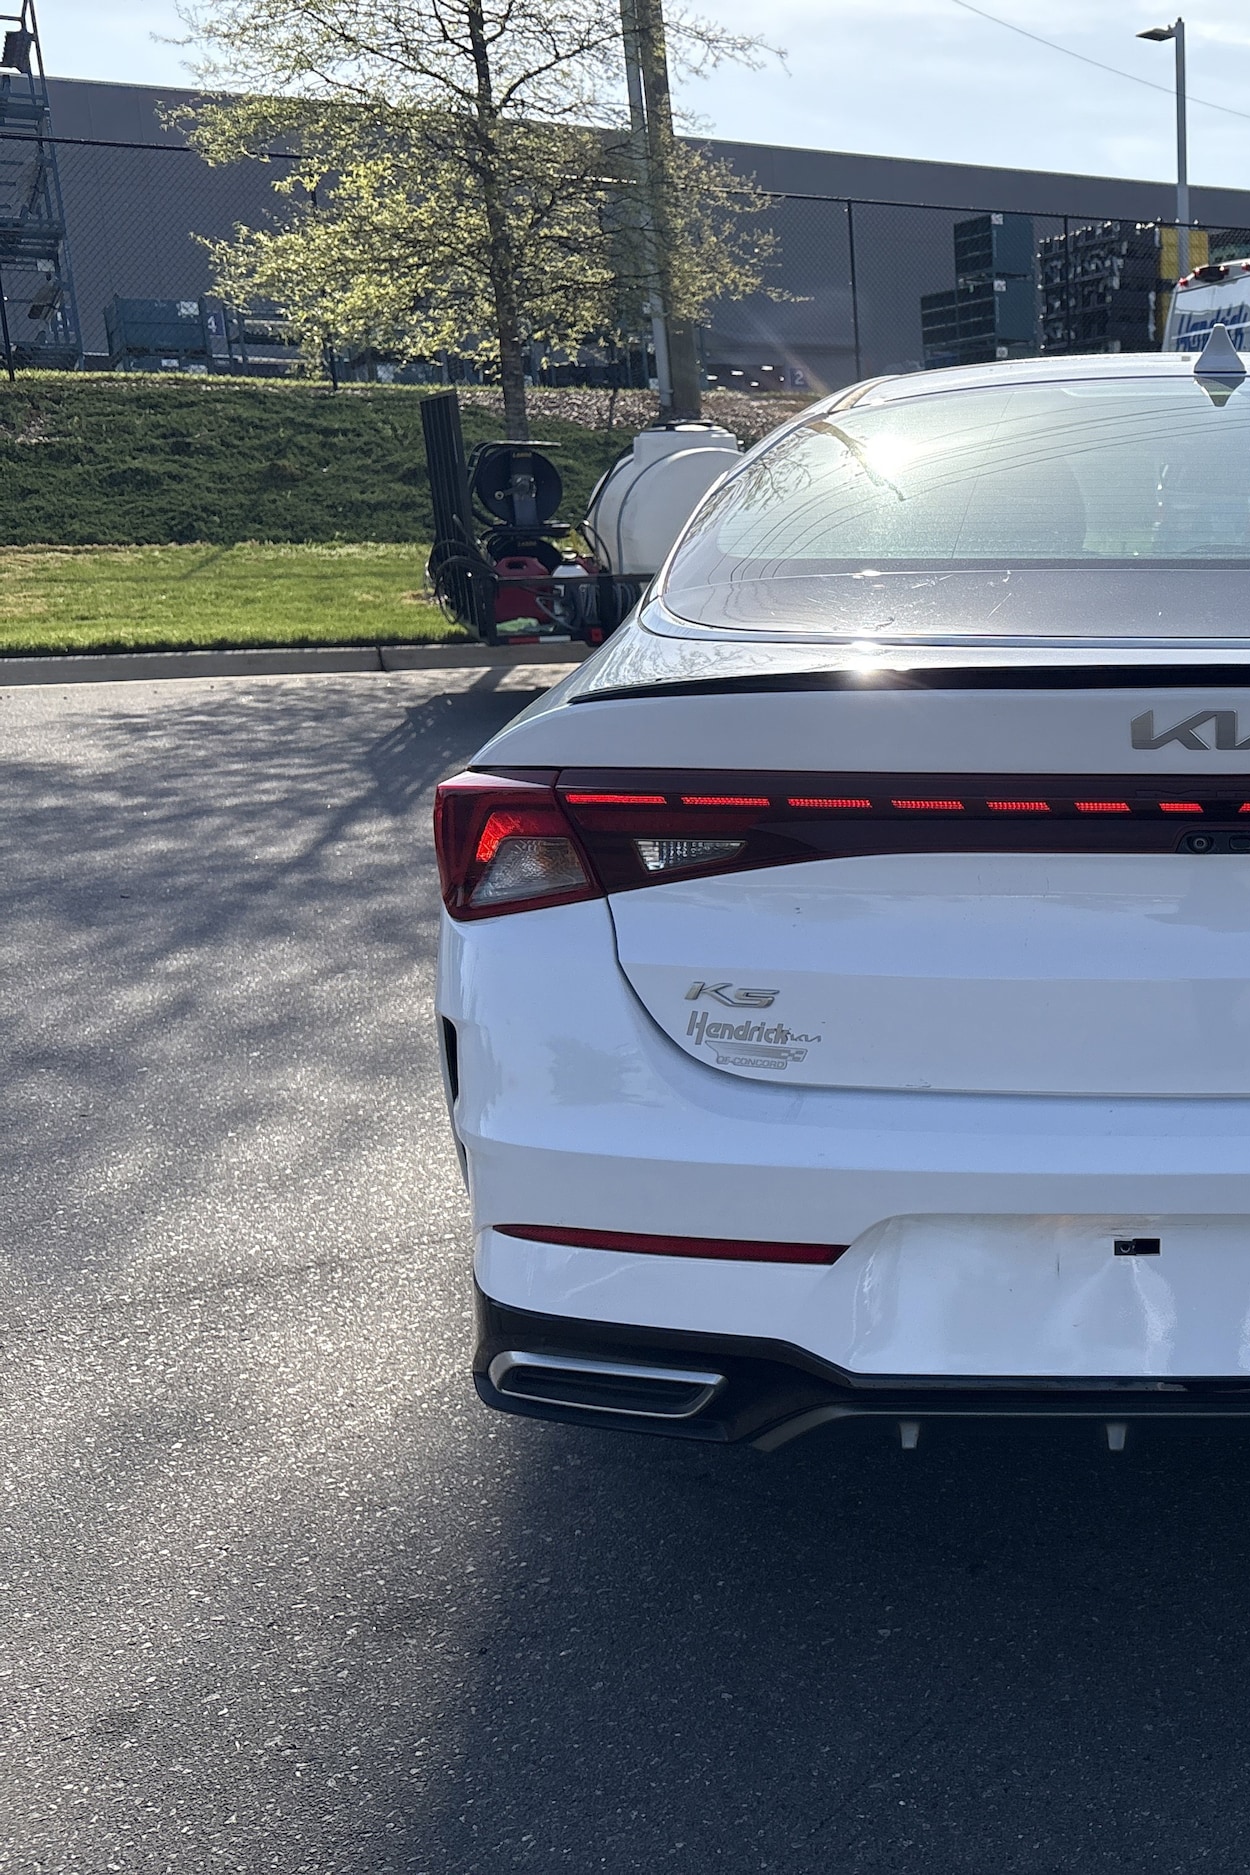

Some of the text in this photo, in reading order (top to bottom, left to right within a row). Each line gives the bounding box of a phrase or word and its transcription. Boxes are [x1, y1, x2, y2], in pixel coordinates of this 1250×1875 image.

[794, 370, 805, 385] 2
[684, 982, 780, 1008] K5
[686, 1011, 791, 1046] Hendrick
